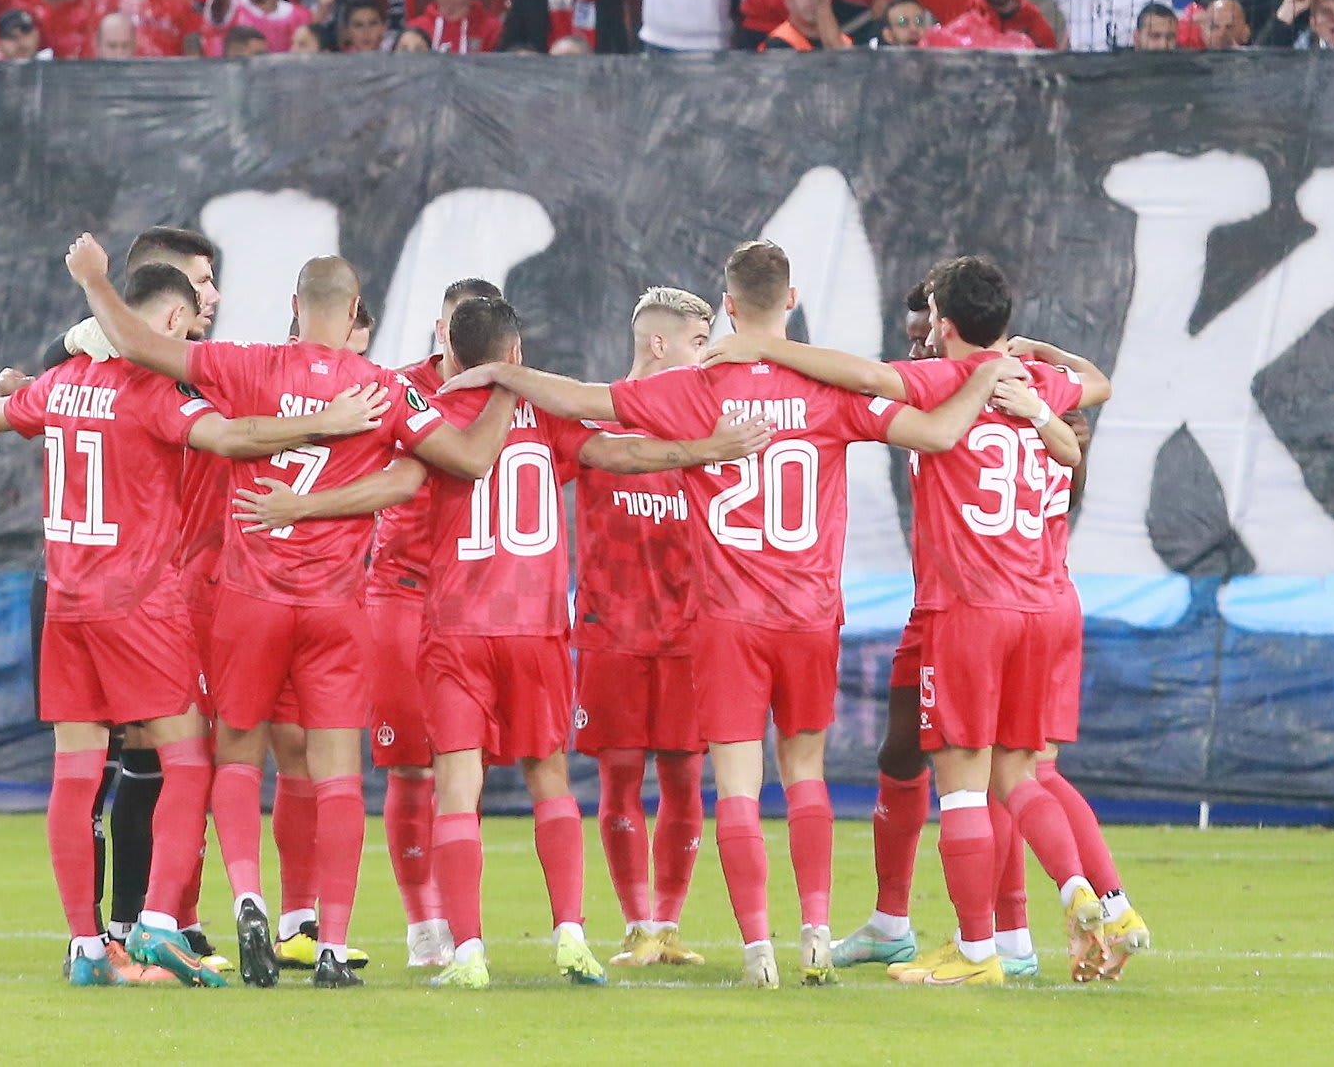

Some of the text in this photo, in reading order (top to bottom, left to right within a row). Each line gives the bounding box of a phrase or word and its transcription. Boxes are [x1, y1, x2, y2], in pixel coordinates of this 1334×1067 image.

[43, 426, 119, 546] 11
[270, 444, 331, 539] 7
[457, 441, 558, 561] 10
[704, 438, 820, 552] 20
[961, 423, 1046, 540] 35
[919, 665, 936, 708] 5
